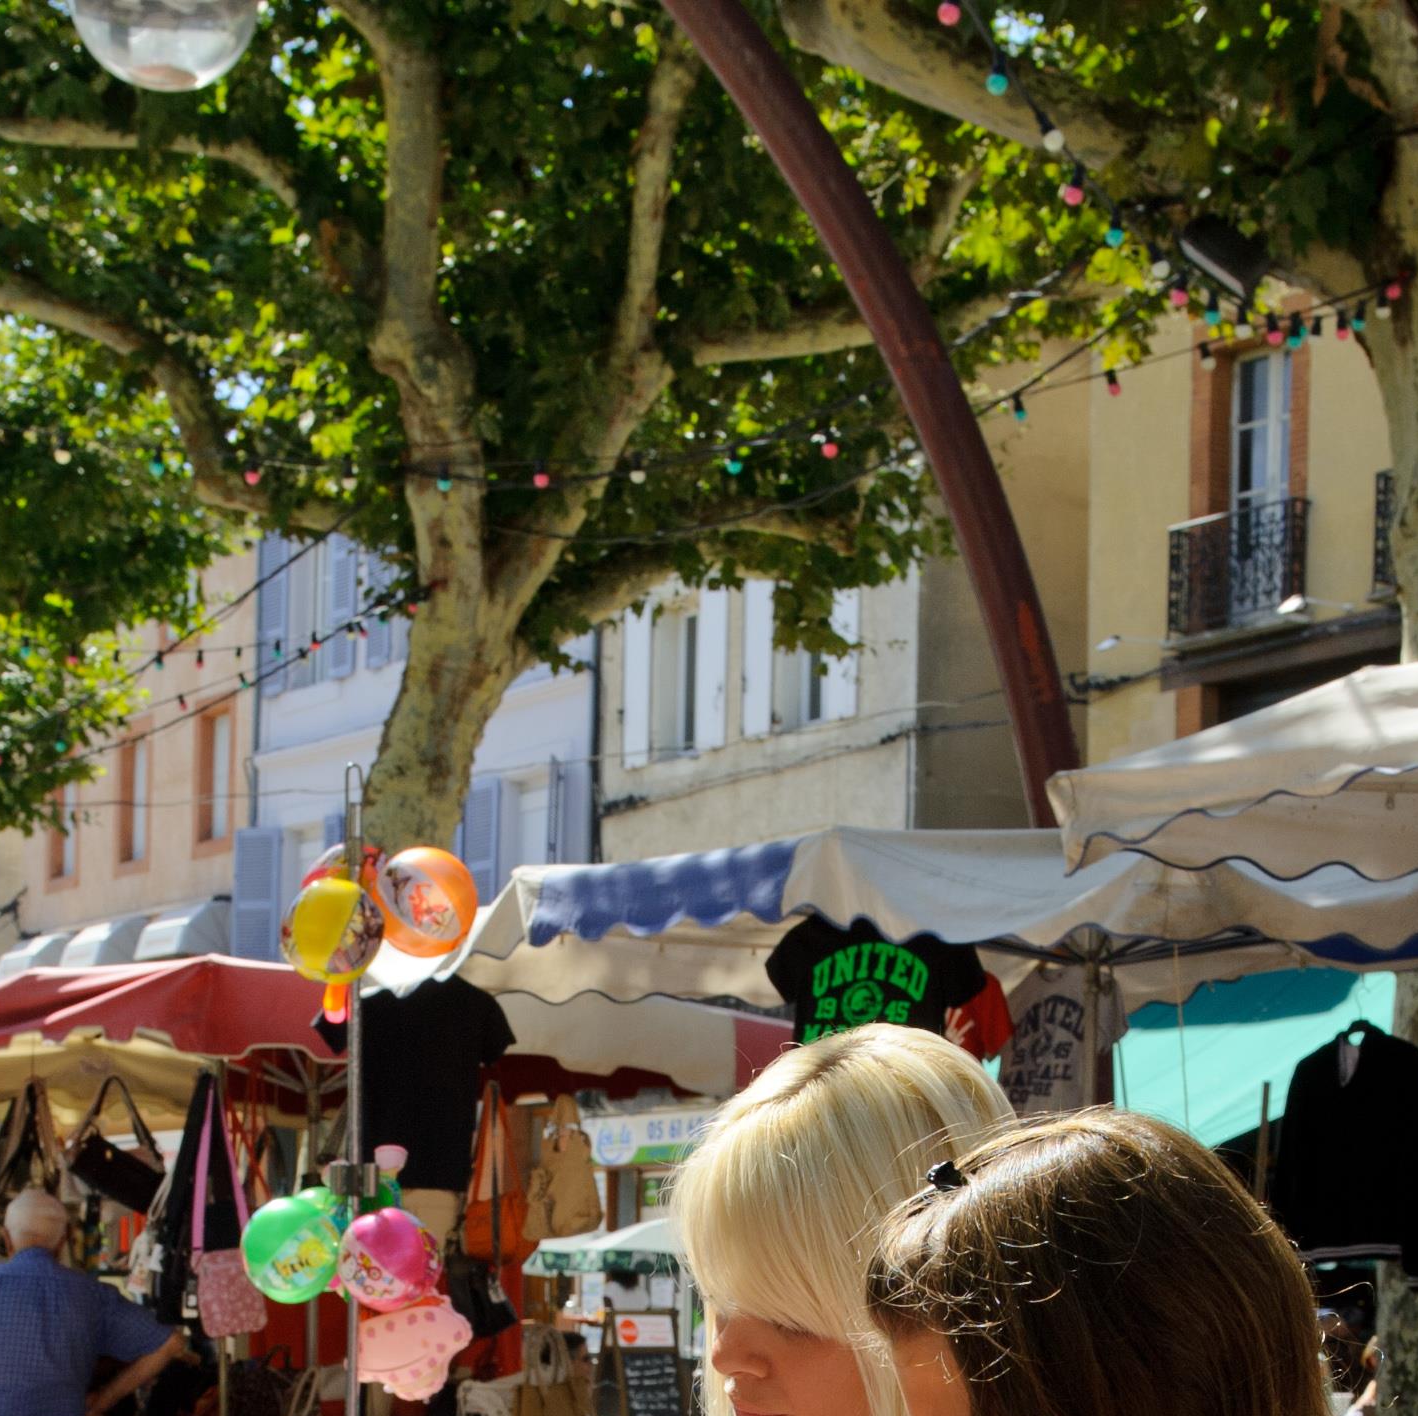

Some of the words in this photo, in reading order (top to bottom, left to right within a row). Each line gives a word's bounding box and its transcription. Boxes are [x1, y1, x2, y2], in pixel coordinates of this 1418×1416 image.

[812, 942, 929, 1002] UNITED
[815, 997, 837, 1020] 19
[884, 1001, 911, 1023] 45
